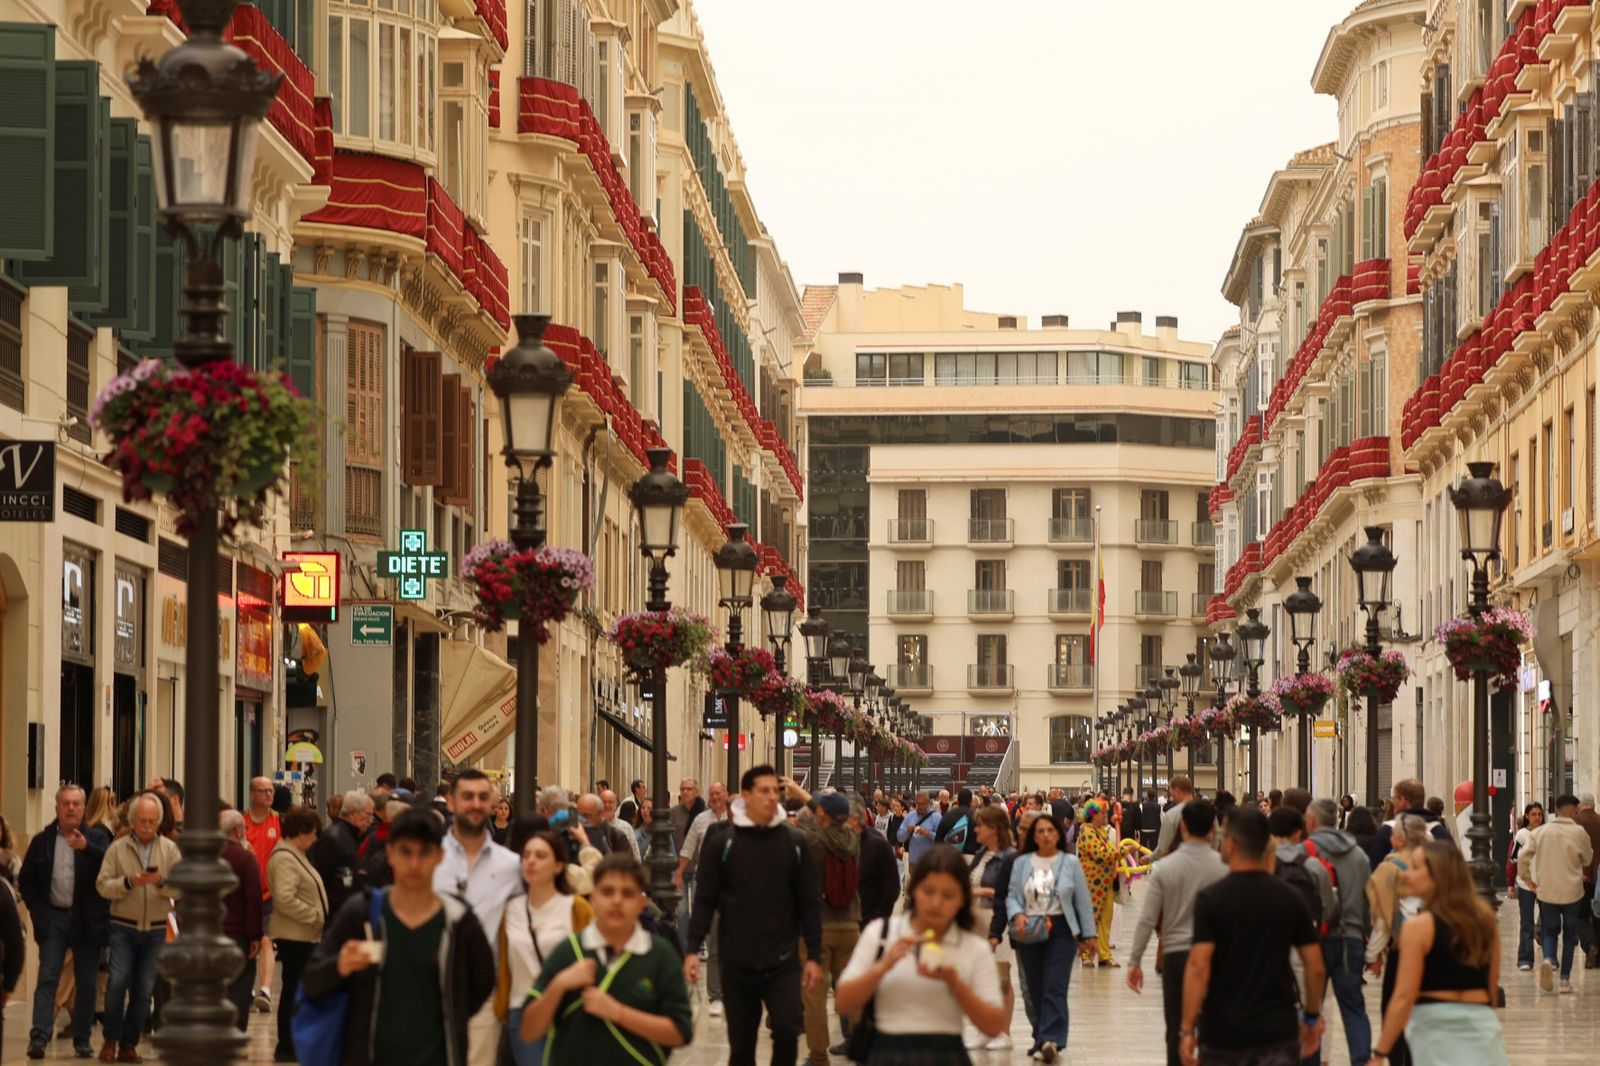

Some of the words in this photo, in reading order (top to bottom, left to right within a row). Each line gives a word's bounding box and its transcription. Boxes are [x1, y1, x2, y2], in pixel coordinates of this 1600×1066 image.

[3, 495, 45, 505] INCCI
[1, 509, 45, 519] OTELES
[389, 556, 445, 573] DIETE
